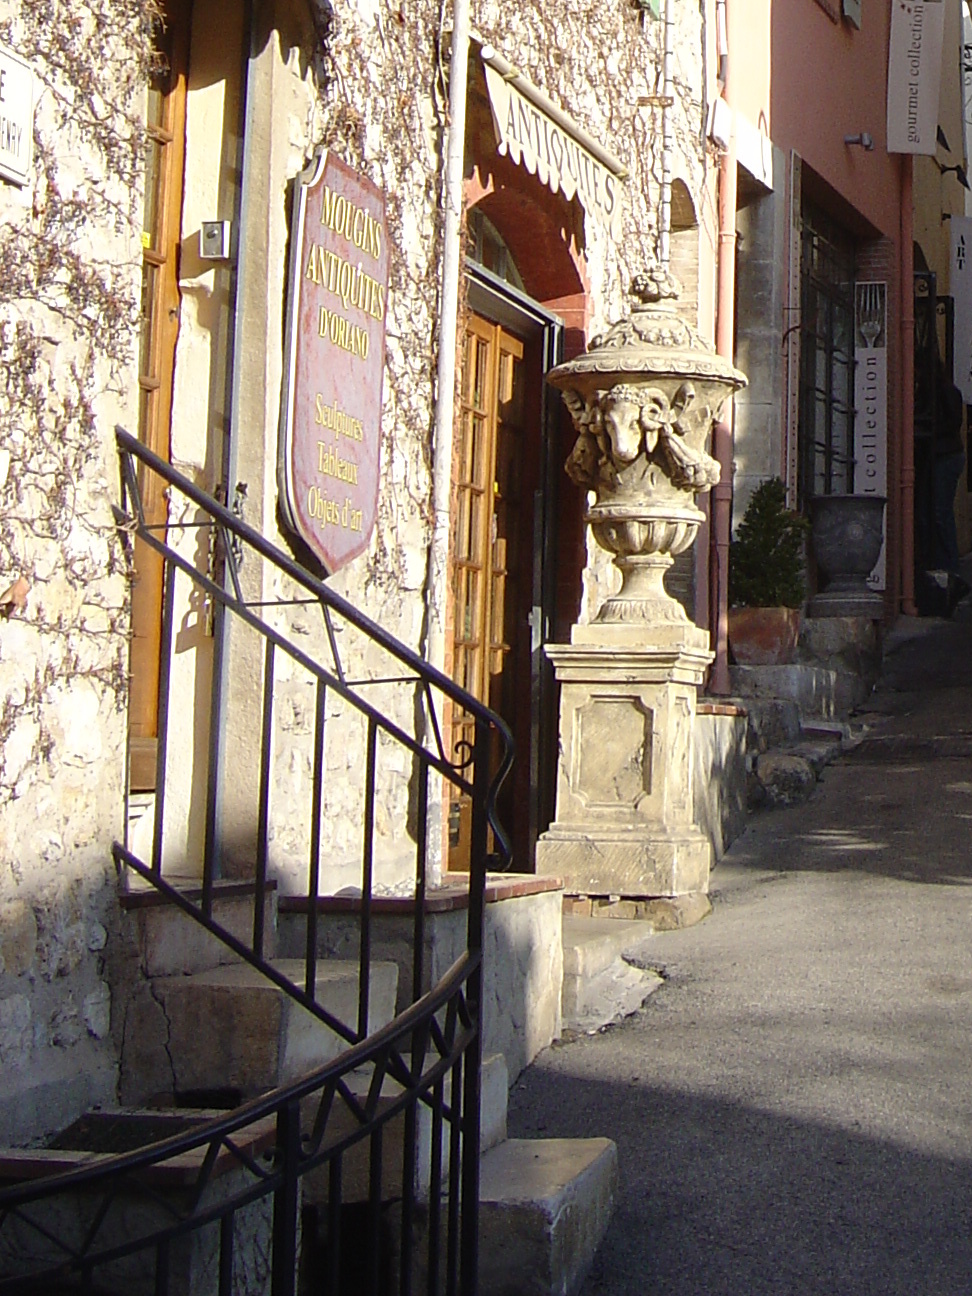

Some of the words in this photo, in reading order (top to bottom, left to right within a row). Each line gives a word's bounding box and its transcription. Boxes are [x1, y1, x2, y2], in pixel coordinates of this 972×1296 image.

[907, 5, 924, 77] collection
[907, 83, 920, 144] gourmet
[506, 92, 615, 215] ANTIQUITES
[320, 184, 382, 259] MOUGINS
[956, 234, 966, 271] ART
[318, 306, 370, 360] D'ORIANO
[315, 393, 364, 442] Sculptures
[862, 356, 877, 478] collection
[317, 441, 358, 486] Tableaux
[308, 486, 340, 530] Objets
[341, 497, 363, 532] d'art
